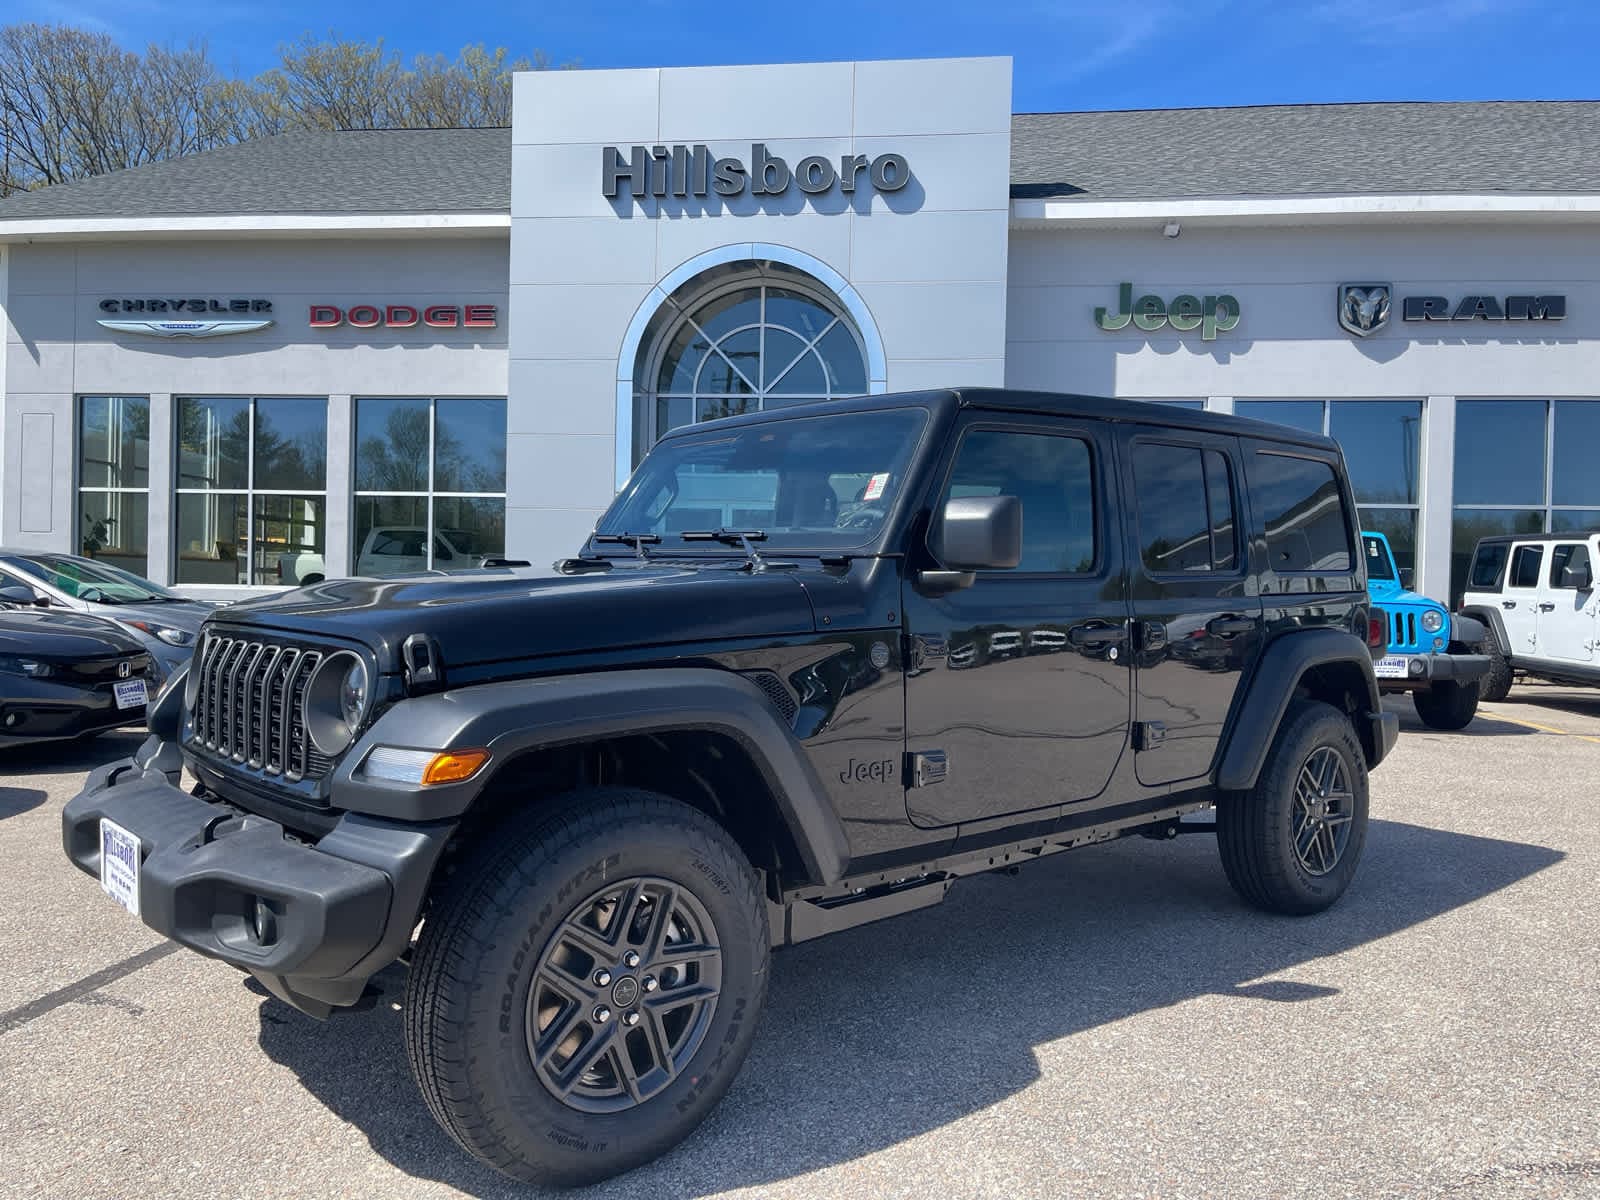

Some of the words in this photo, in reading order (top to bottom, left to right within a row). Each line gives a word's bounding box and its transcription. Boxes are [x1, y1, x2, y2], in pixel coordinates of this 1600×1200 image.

[602, 143, 910, 197] Hillsboro
[99, 299, 273, 313] CHRYSLER
[309, 305, 498, 328] DODGE
[1094, 282, 1240, 341] Jeep
[1402, 295, 1568, 322] RAM
[839, 757, 894, 785] Jeep
[499, 904, 553, 1034] ROADIAN
[676, 998, 747, 1113] NEXEN
